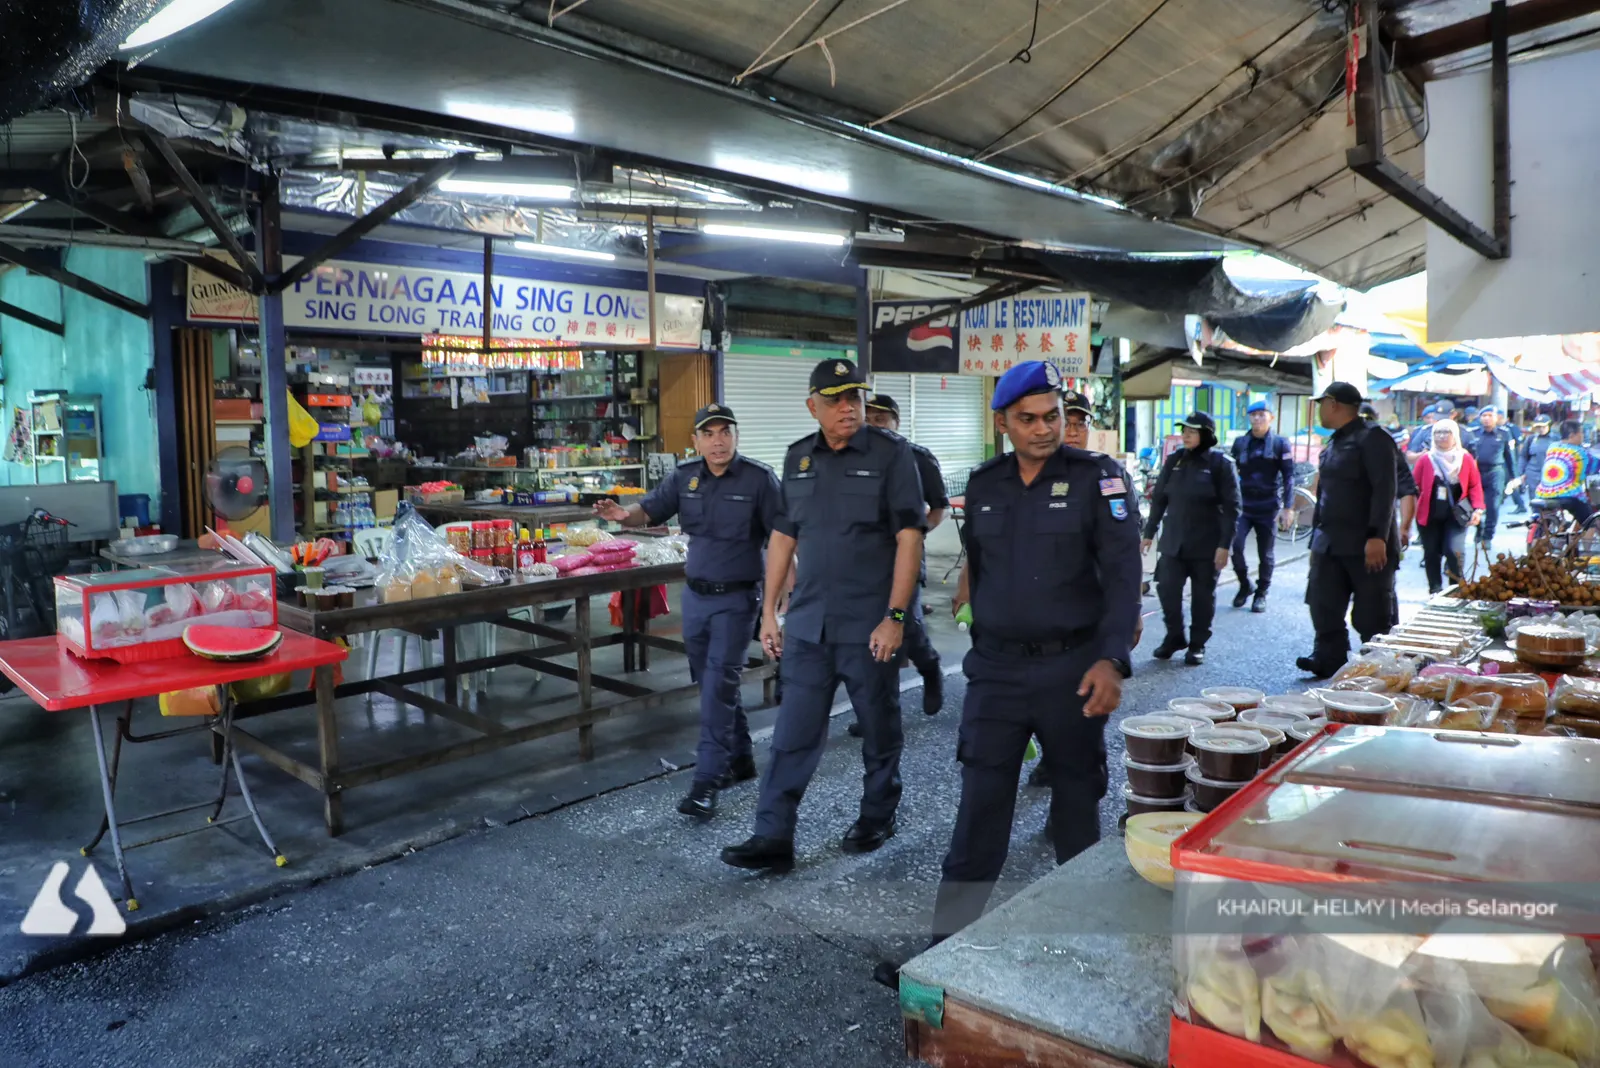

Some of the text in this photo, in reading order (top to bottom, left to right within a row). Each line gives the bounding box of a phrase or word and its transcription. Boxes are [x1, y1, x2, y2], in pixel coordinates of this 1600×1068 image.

[294, 265, 648, 320] PERNIAGAAN SING LONG
[305, 299, 356, 321] SING
[368, 304, 426, 325] LONG
[532, 316, 556, 333] CO
[875, 304, 957, 329] PEPSI
[995, 299, 1008, 329] LE
[1013, 298, 1086, 328] RESTAURANT
